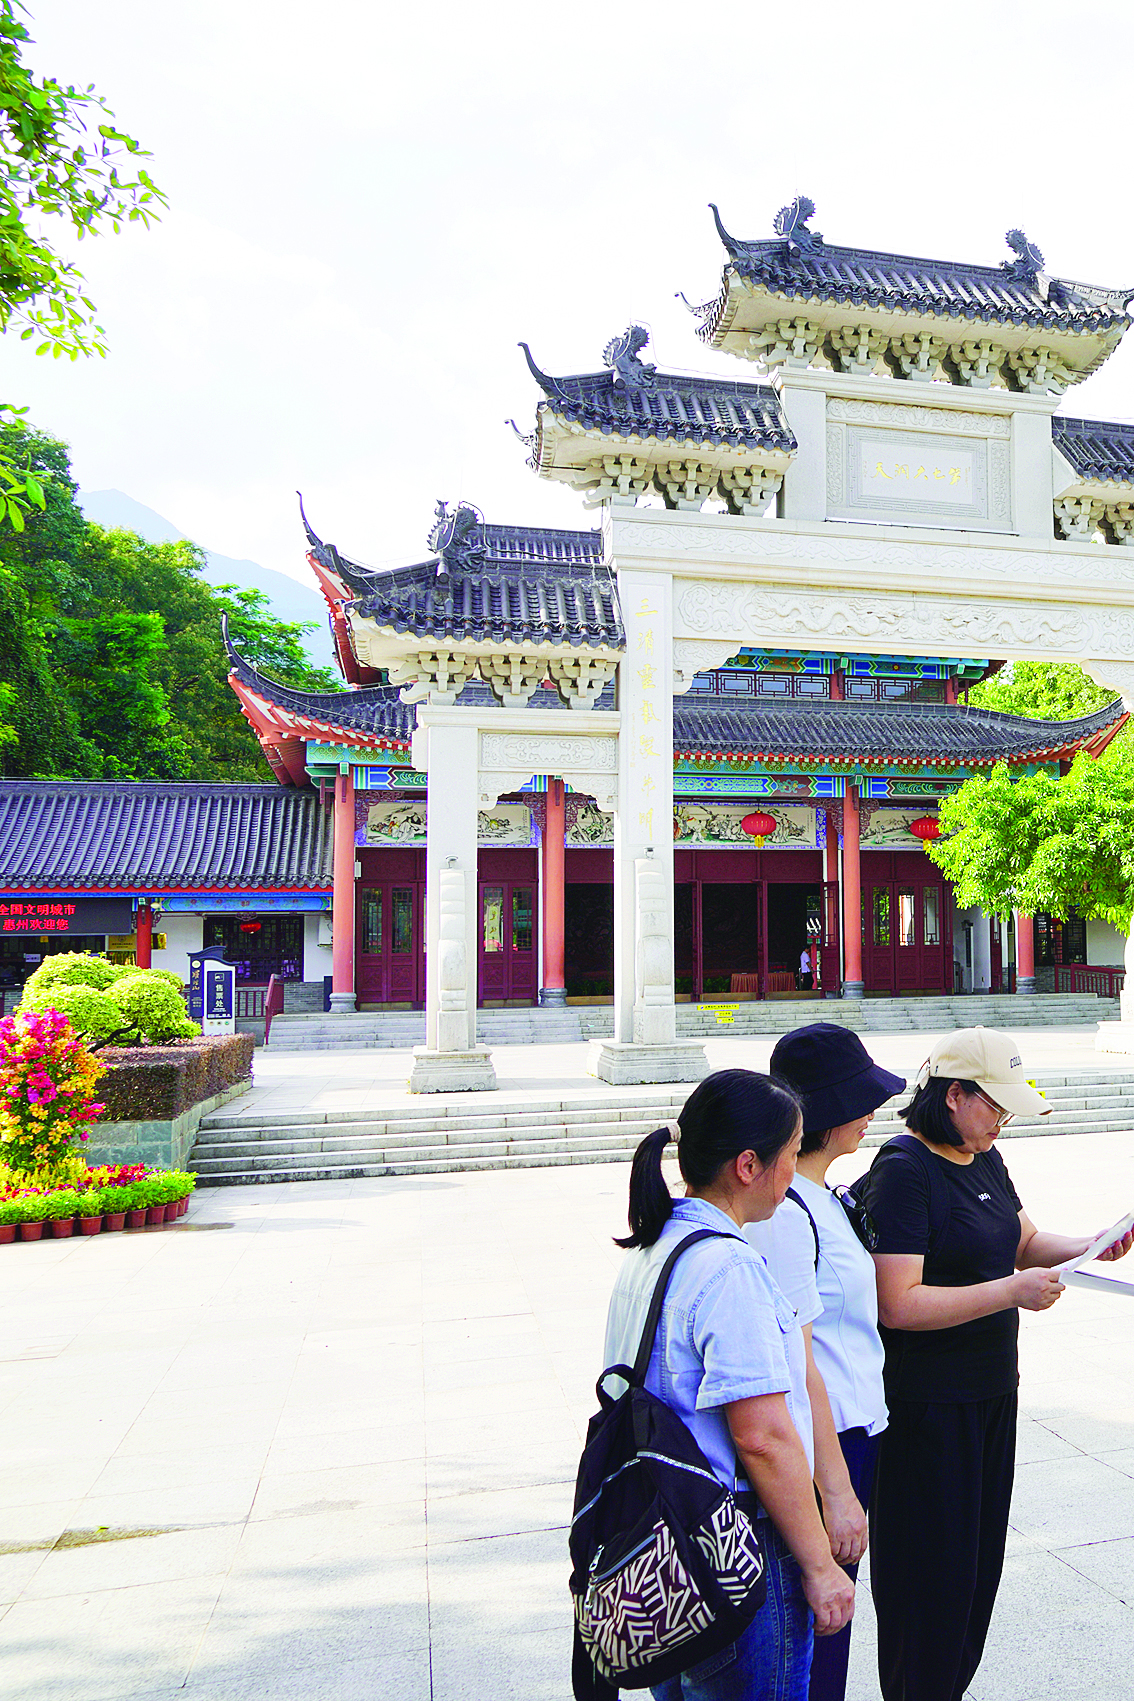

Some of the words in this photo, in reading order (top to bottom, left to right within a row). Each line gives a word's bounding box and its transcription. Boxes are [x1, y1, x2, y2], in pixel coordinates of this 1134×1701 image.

[0, 904, 76, 916] 全国文明城市
[3, 918, 70, 931] 惠州欢迎您
[215, 984, 224, 1008] 售票处
